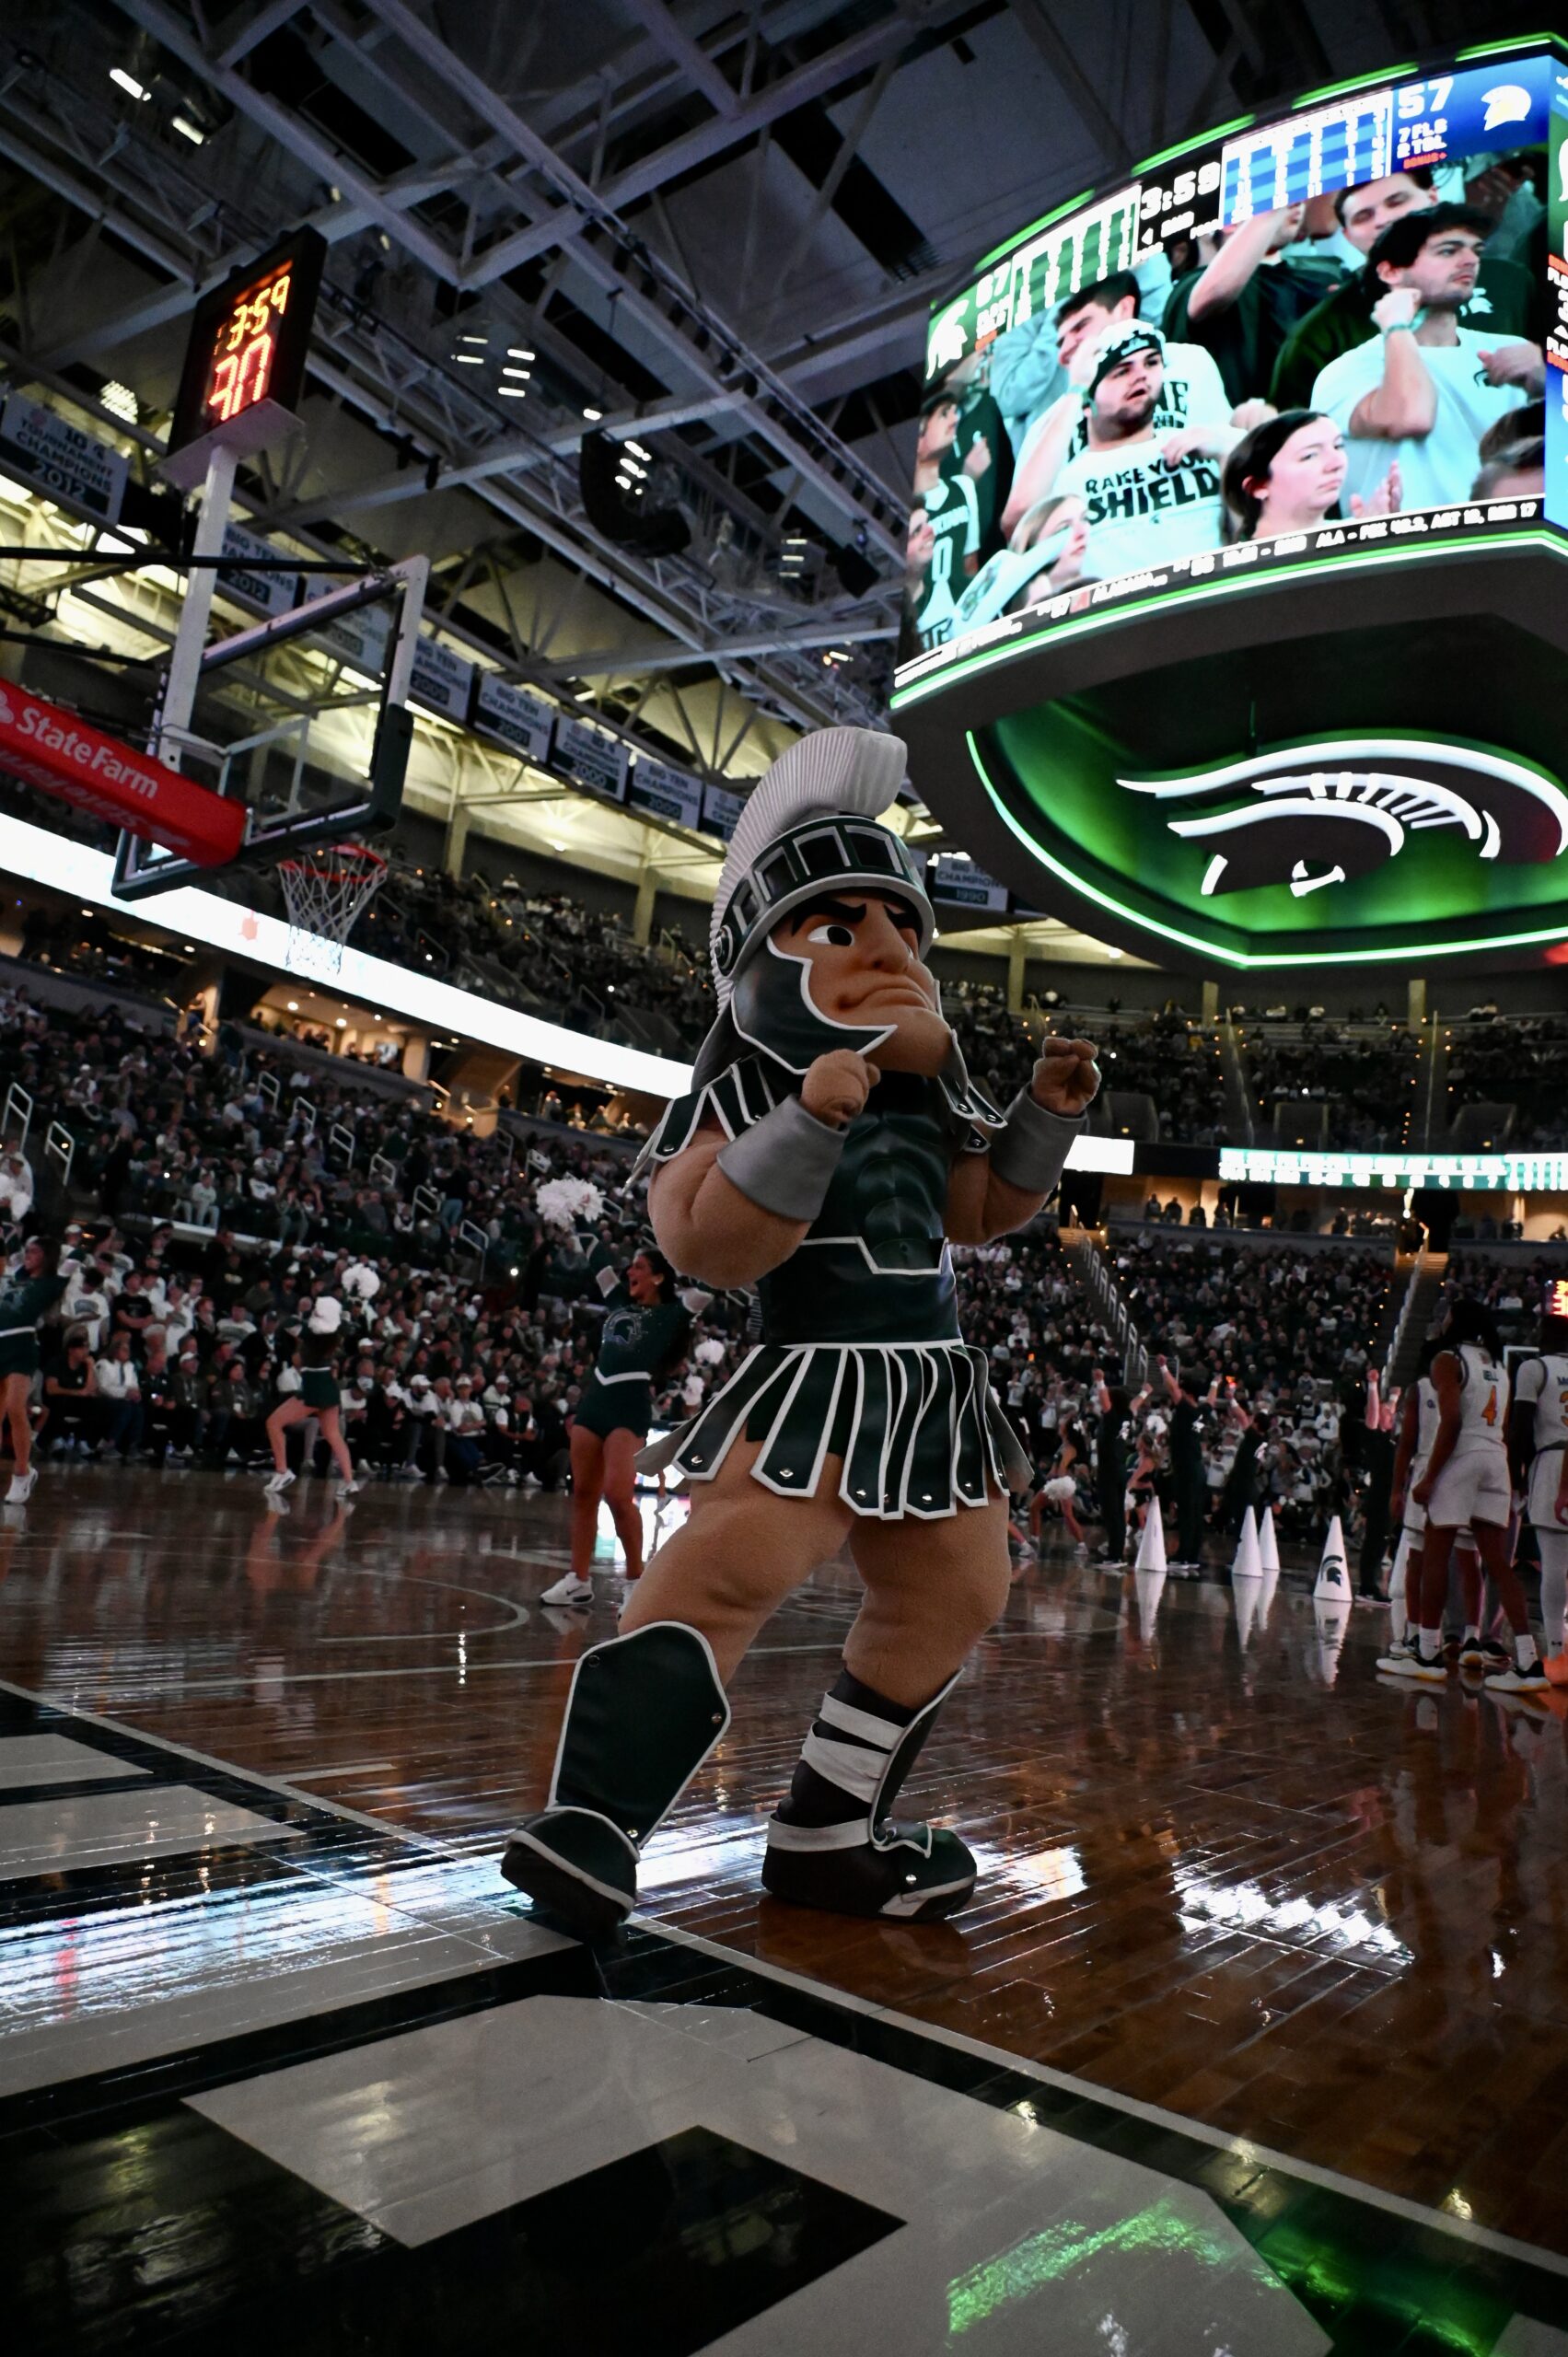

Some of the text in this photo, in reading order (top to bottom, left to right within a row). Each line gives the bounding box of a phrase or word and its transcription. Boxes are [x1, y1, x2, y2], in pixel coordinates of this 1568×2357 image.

[1398, 75, 1454, 119] 57
[1399, 127, 1411, 143] 7
[1141, 162, 1221, 220] 3:59
[226, 275, 290, 351] 3:59
[17, 431, 111, 493] CHAMPIONS
[21, 416, 112, 476] TOURNAMENT
[31, 461, 86, 501] 2012
[1087, 467, 1220, 525] SHIELD
[230, 571, 270, 597] 2012
[482, 691, 550, 736] CHAMPIONS
[572, 760, 607, 787] 2000
[636, 772, 699, 807] CHAMPIONS
[956, 889, 986, 902] 1990
[1481, 1385, 1497, 1426] 4
